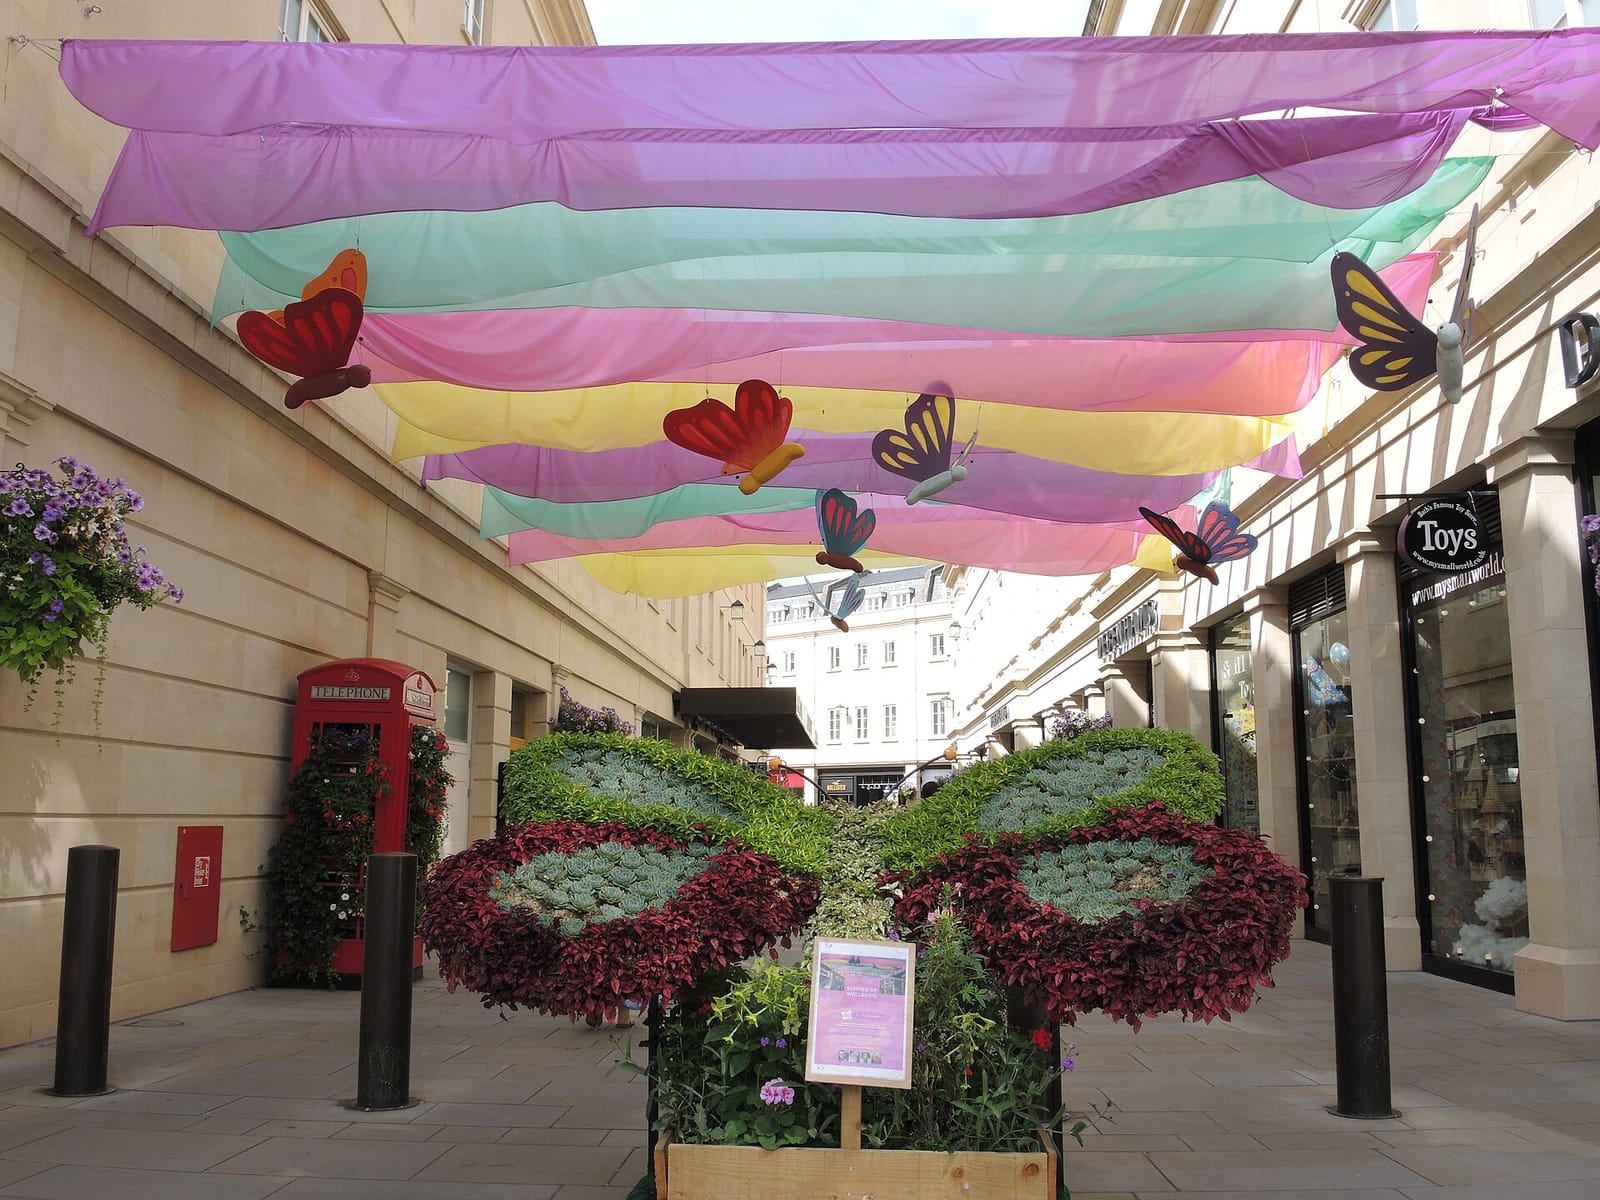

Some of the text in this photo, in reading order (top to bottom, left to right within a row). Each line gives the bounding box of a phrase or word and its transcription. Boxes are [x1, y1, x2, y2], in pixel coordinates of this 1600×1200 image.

[1456, 504, 1465, 513] Toy
[1417, 520, 1478, 556] Toys
[1412, 550, 1486, 570] www.mysmallworld.co.uk
[315, 686, 388, 699] TELEPHONE
